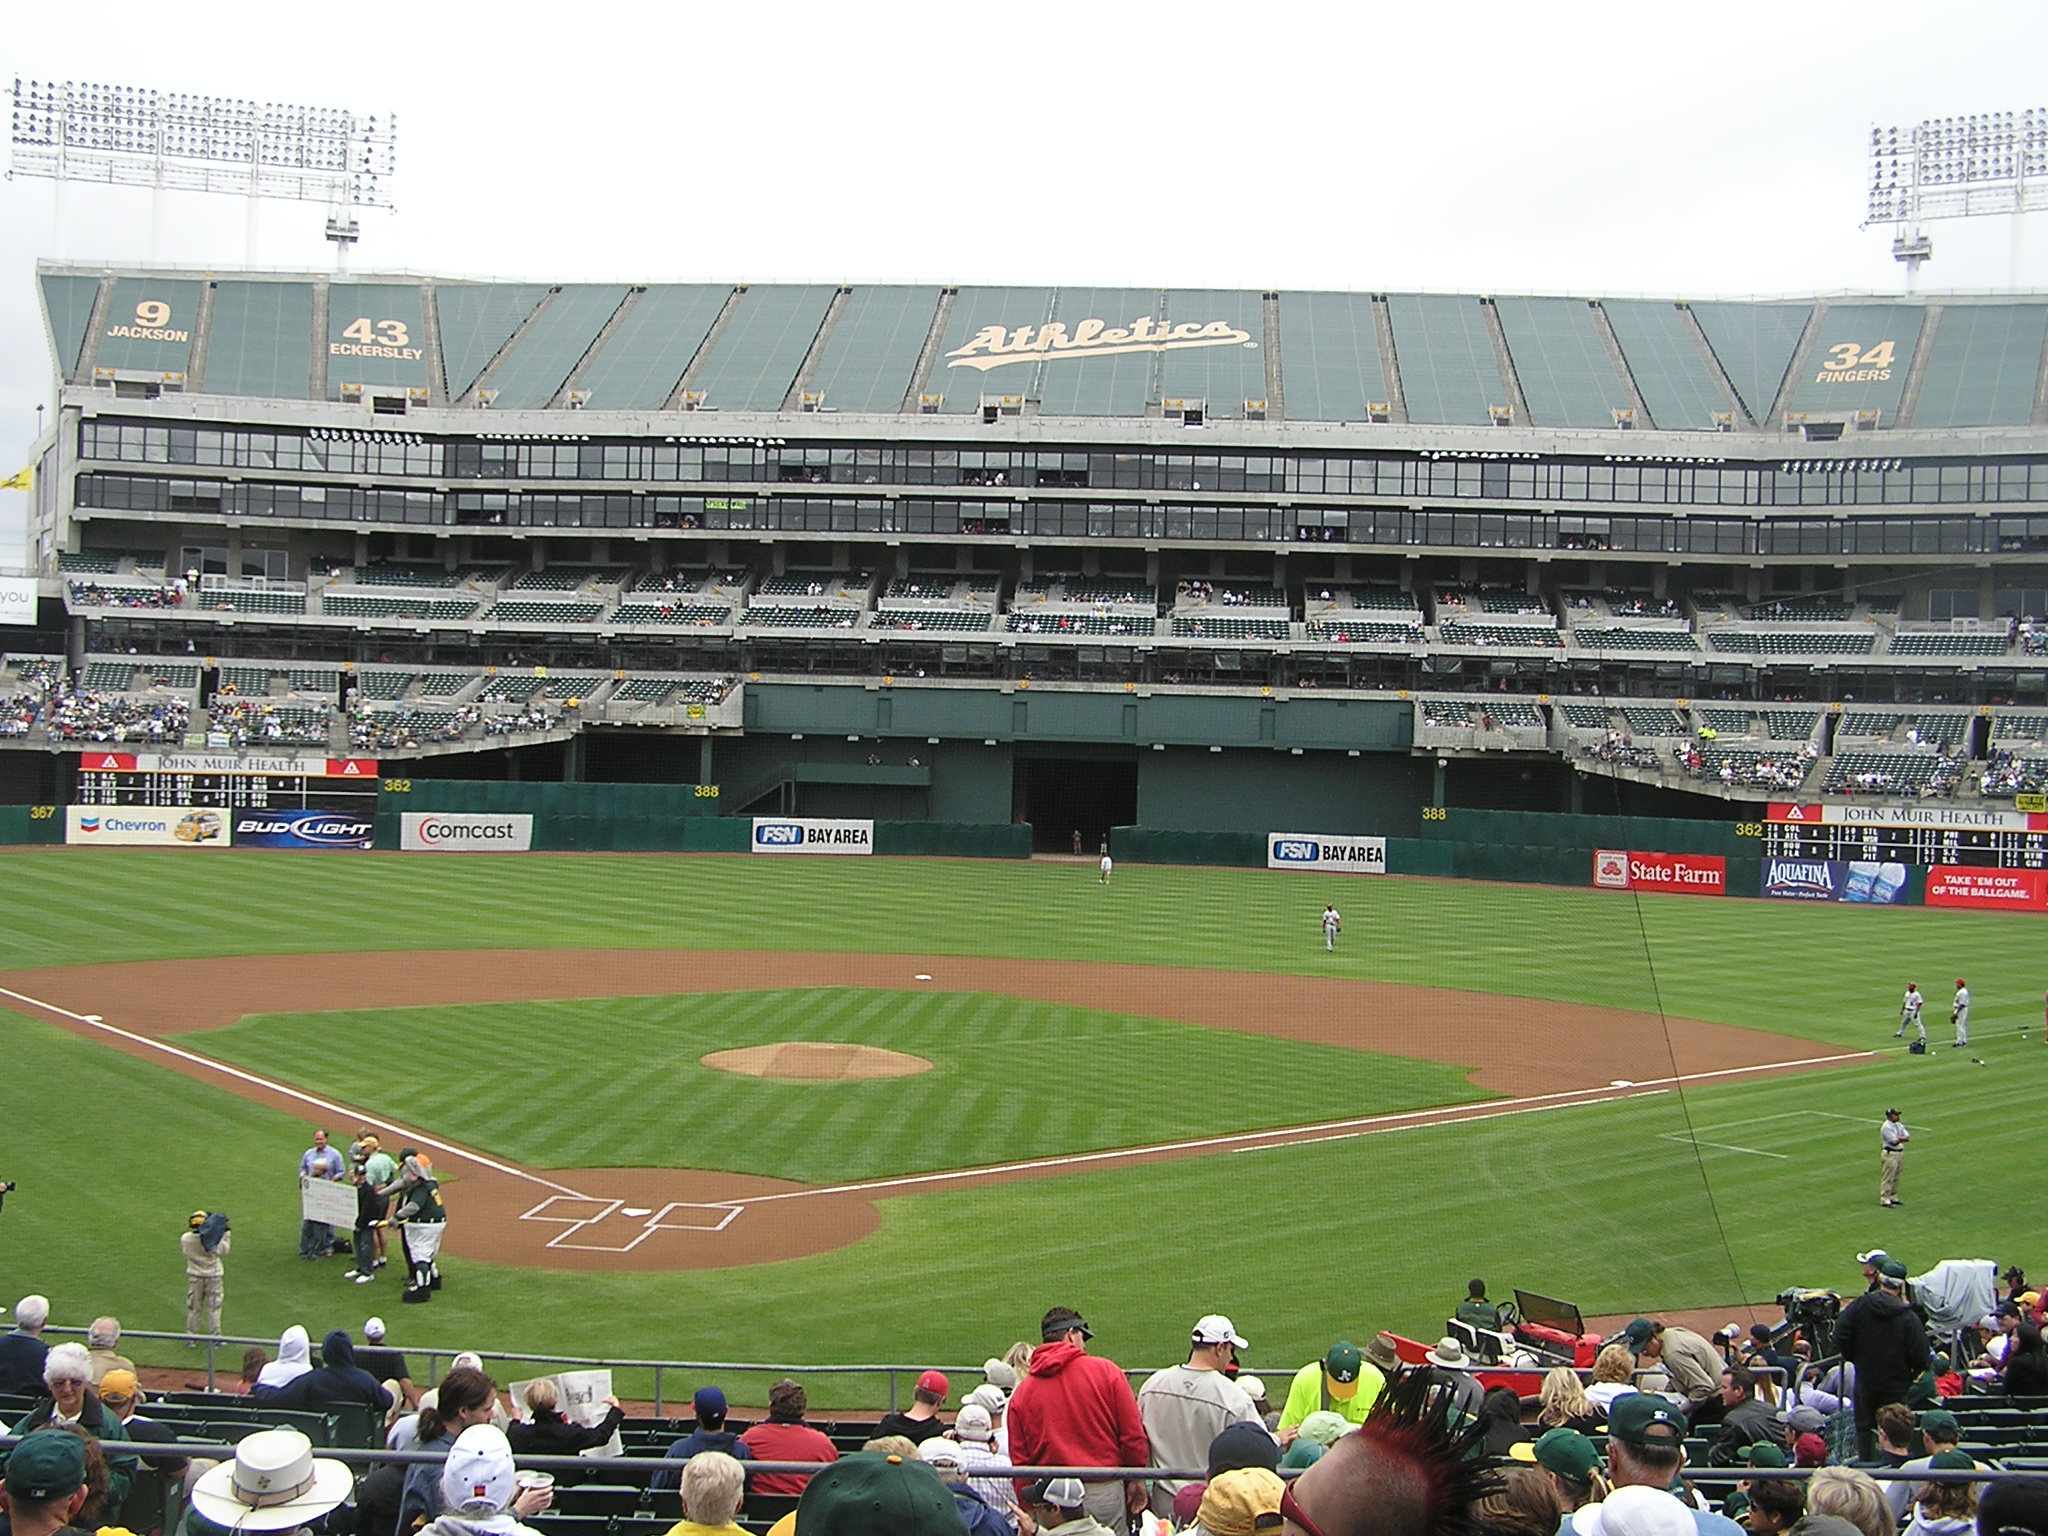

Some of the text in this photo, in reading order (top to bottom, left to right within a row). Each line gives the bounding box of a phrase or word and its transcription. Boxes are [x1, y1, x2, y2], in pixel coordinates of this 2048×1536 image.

[135, 300, 171, 328] 9
[107, 325, 188, 342] JACKSON
[342, 317, 410, 347] 43
[945, 316, 1250, 364] Athletics
[330, 343, 423, 360] ECKERSLEY
[1823, 341, 1896, 371] 34
[1815, 369, 1892, 383] FINGERS
[158, 756, 305, 772] JOHN MUIR HEALTH
[384, 779, 412, 792] 362
[694, 785, 720, 798] 388
[30, 805, 56, 820] 367
[1422, 807, 1447, 821] 388
[1844, 807, 2003, 826] JOHN MUIR HEALTH
[104, 818, 167, 832] Chevron
[236, 820, 291, 833] BUD
[301, 823, 373, 835] LIGHT
[1736, 823, 1763, 837] 362
[762, 826, 869, 844] FSN BAY AREA
[1279, 841, 1384, 863] FSN BAY AREA
[1630, 860, 1721, 885] State Farm
[1765, 858, 1834, 889] AQUAFINA
[1944, 875, 1972, 885] TAKE
[1994, 877, 2018, 887] OUT
[1932, 886, 2030, 899] OF THE BALLGAME.
